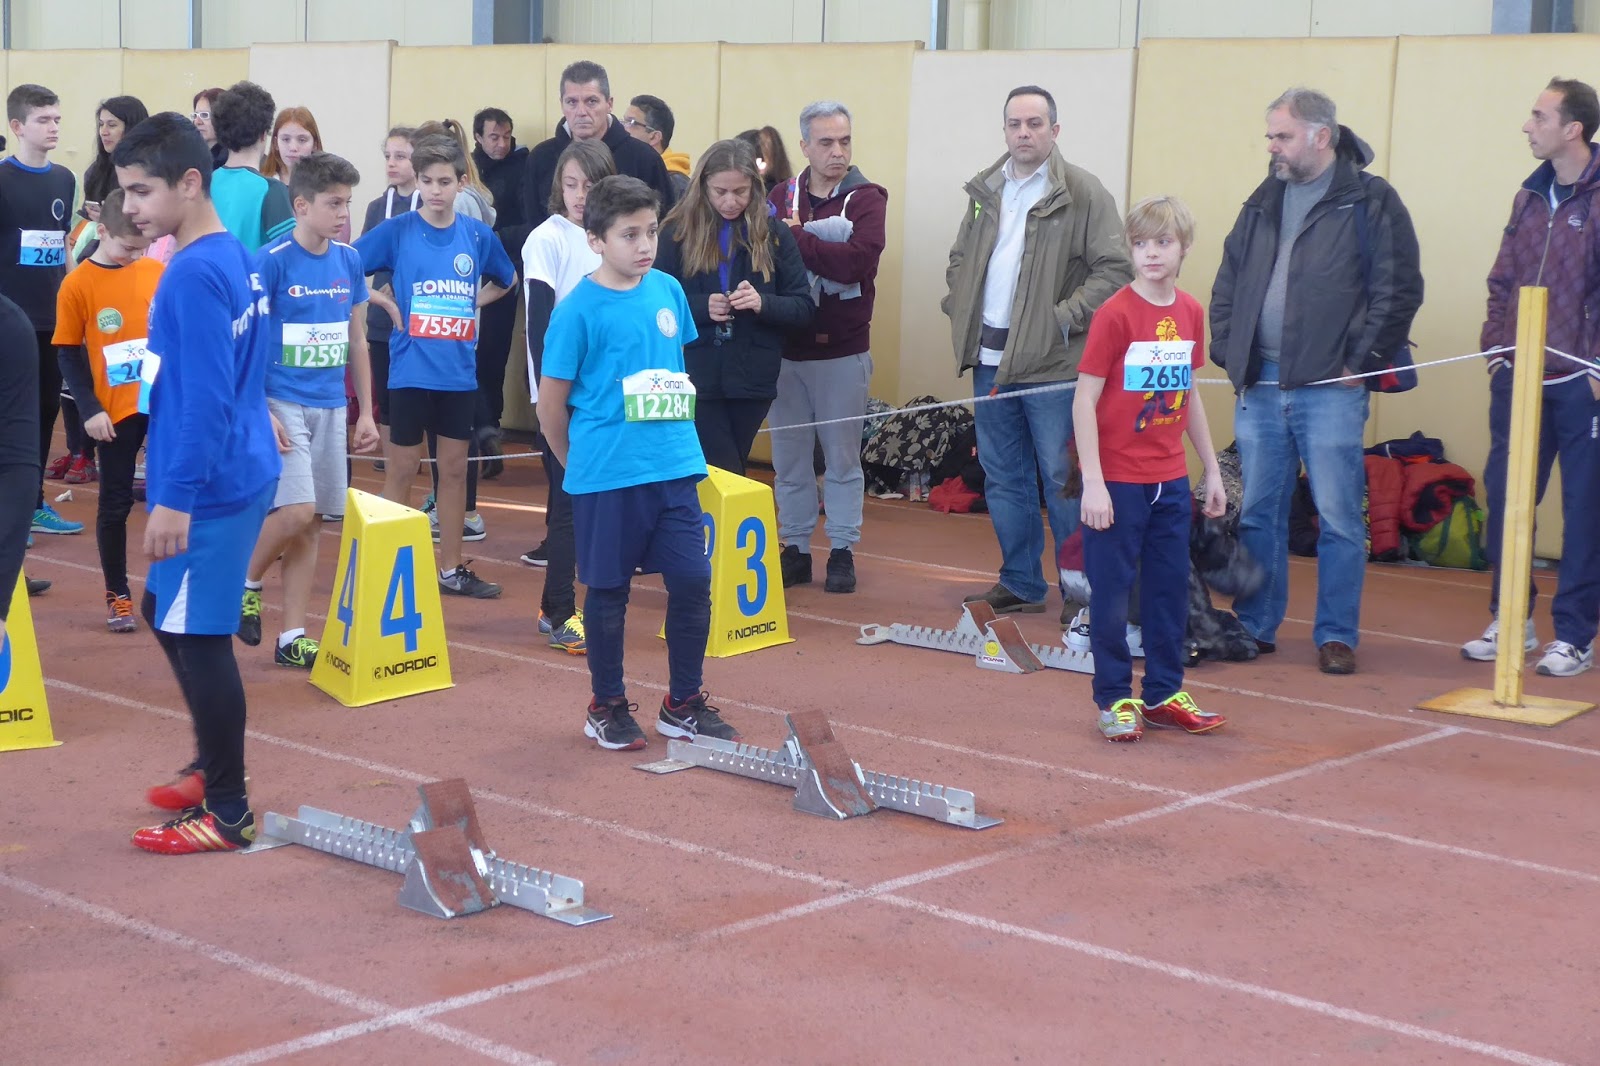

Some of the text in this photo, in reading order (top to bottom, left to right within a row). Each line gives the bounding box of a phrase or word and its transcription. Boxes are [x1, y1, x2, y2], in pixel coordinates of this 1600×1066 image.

[287, 285, 350, 298] Champion
[418, 315, 471, 337] 75547
[1141, 365, 1189, 389] 2650
[636, 394, 690, 418] 12284
[736, 516, 768, 618] 3
[337, 538, 358, 647] 4
[380, 545, 423, 653] 4
[735, 621, 777, 640] NORDIC
[329, 654, 351, 676] NORDIC
[384, 655, 437, 678] NORDIC
